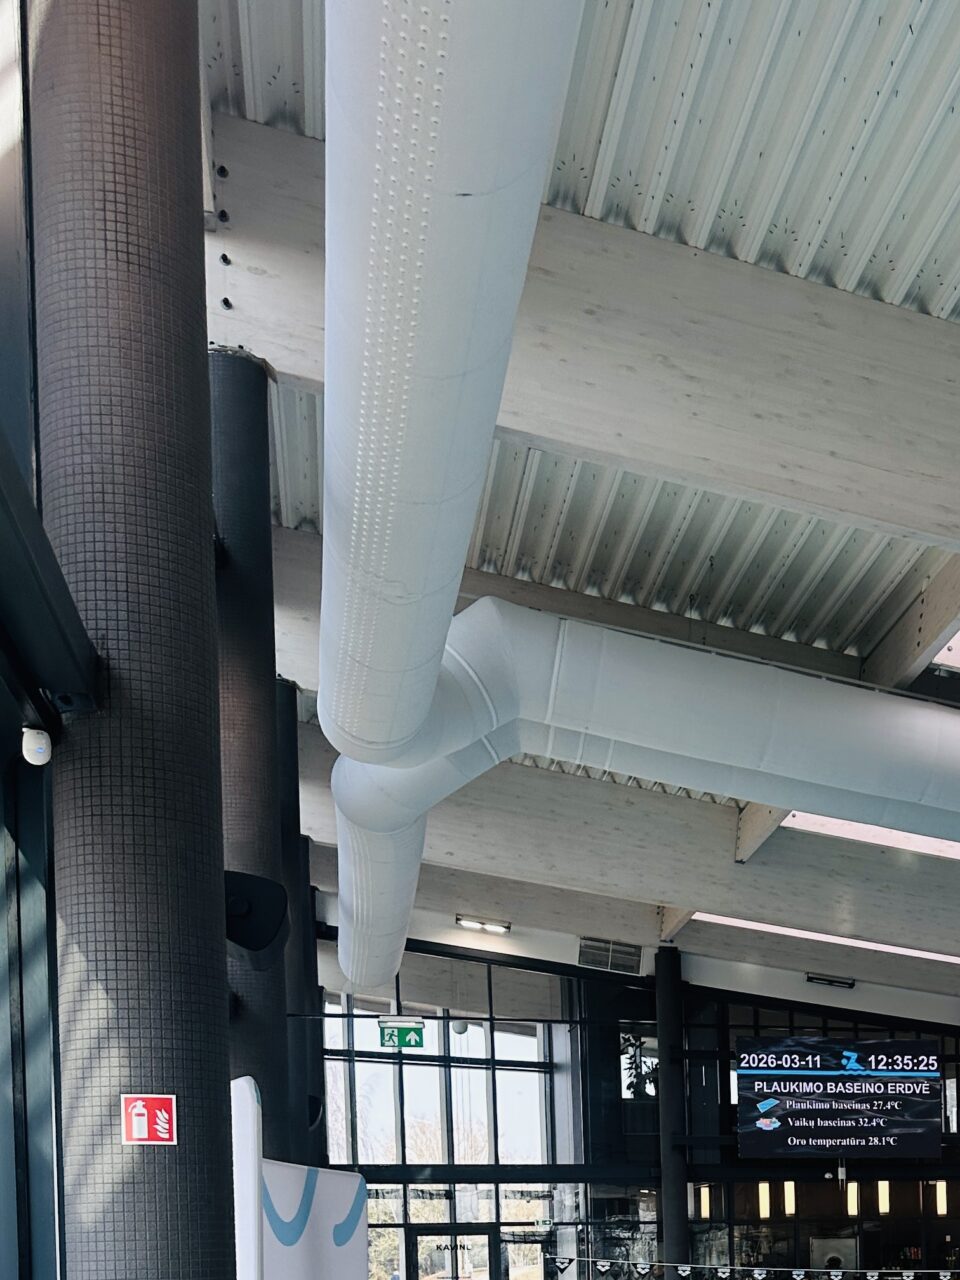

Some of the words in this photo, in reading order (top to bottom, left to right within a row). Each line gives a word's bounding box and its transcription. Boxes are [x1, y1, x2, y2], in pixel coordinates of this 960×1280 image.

[740, 1053, 821, 1068] 2026-03-11
[868, 1054, 938, 1070] 12:35:25
[754, 1081, 824, 1094] PLAUKIMO
[826, 1081, 885, 1094] BASEINO
[887, 1080, 931, 1094] ERDVĖ
[785, 1100, 830, 1111] Plaukimo
[832, 1100, 871, 1111] baseinas
[787, 1117, 815, 1129] Vaikų
[817, 1117, 856, 1128] baseinas
[787, 1137, 807, 1146] Oro
[808, 1137, 866, 1148] temperatūra
